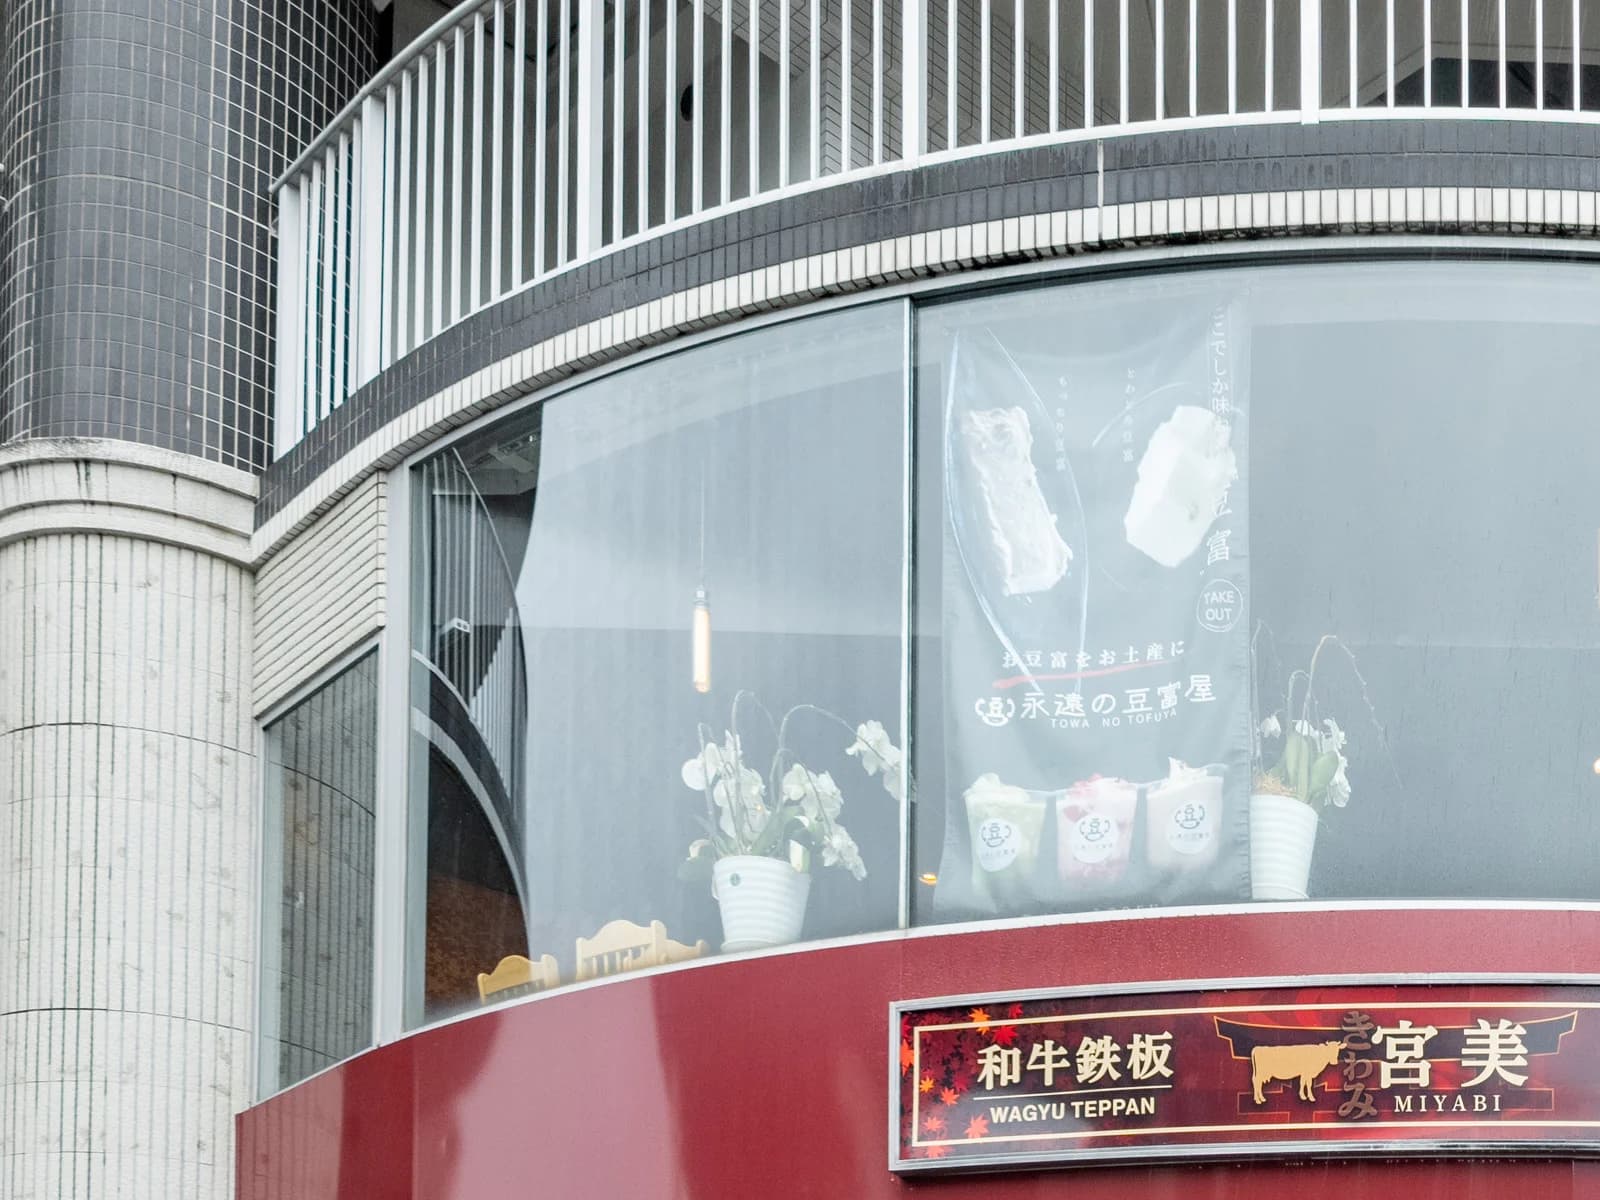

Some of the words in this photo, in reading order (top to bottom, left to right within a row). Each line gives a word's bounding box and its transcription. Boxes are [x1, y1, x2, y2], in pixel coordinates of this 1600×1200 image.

[1204, 590, 1235, 604] TAKE
[1205, 607, 1232, 621] OUT
[1020, 674, 1216, 719] 永遠の豆富屋
[1050, 718, 1090, 729] TOWA
[1102, 716, 1121, 728] NO
[1127, 710, 1178, 726] TOFUYA
[977, 1030, 1174, 1090] 和牛鉄板
[1338, 1010, 1377, 1120] きわみ
[1371, 1018, 1529, 1088] 宮美
[990, 1102, 1066, 1124] WAGYU
[1071, 1097, 1156, 1118] TEPPAN
[1393, 1094, 1501, 1113] MIYABI
